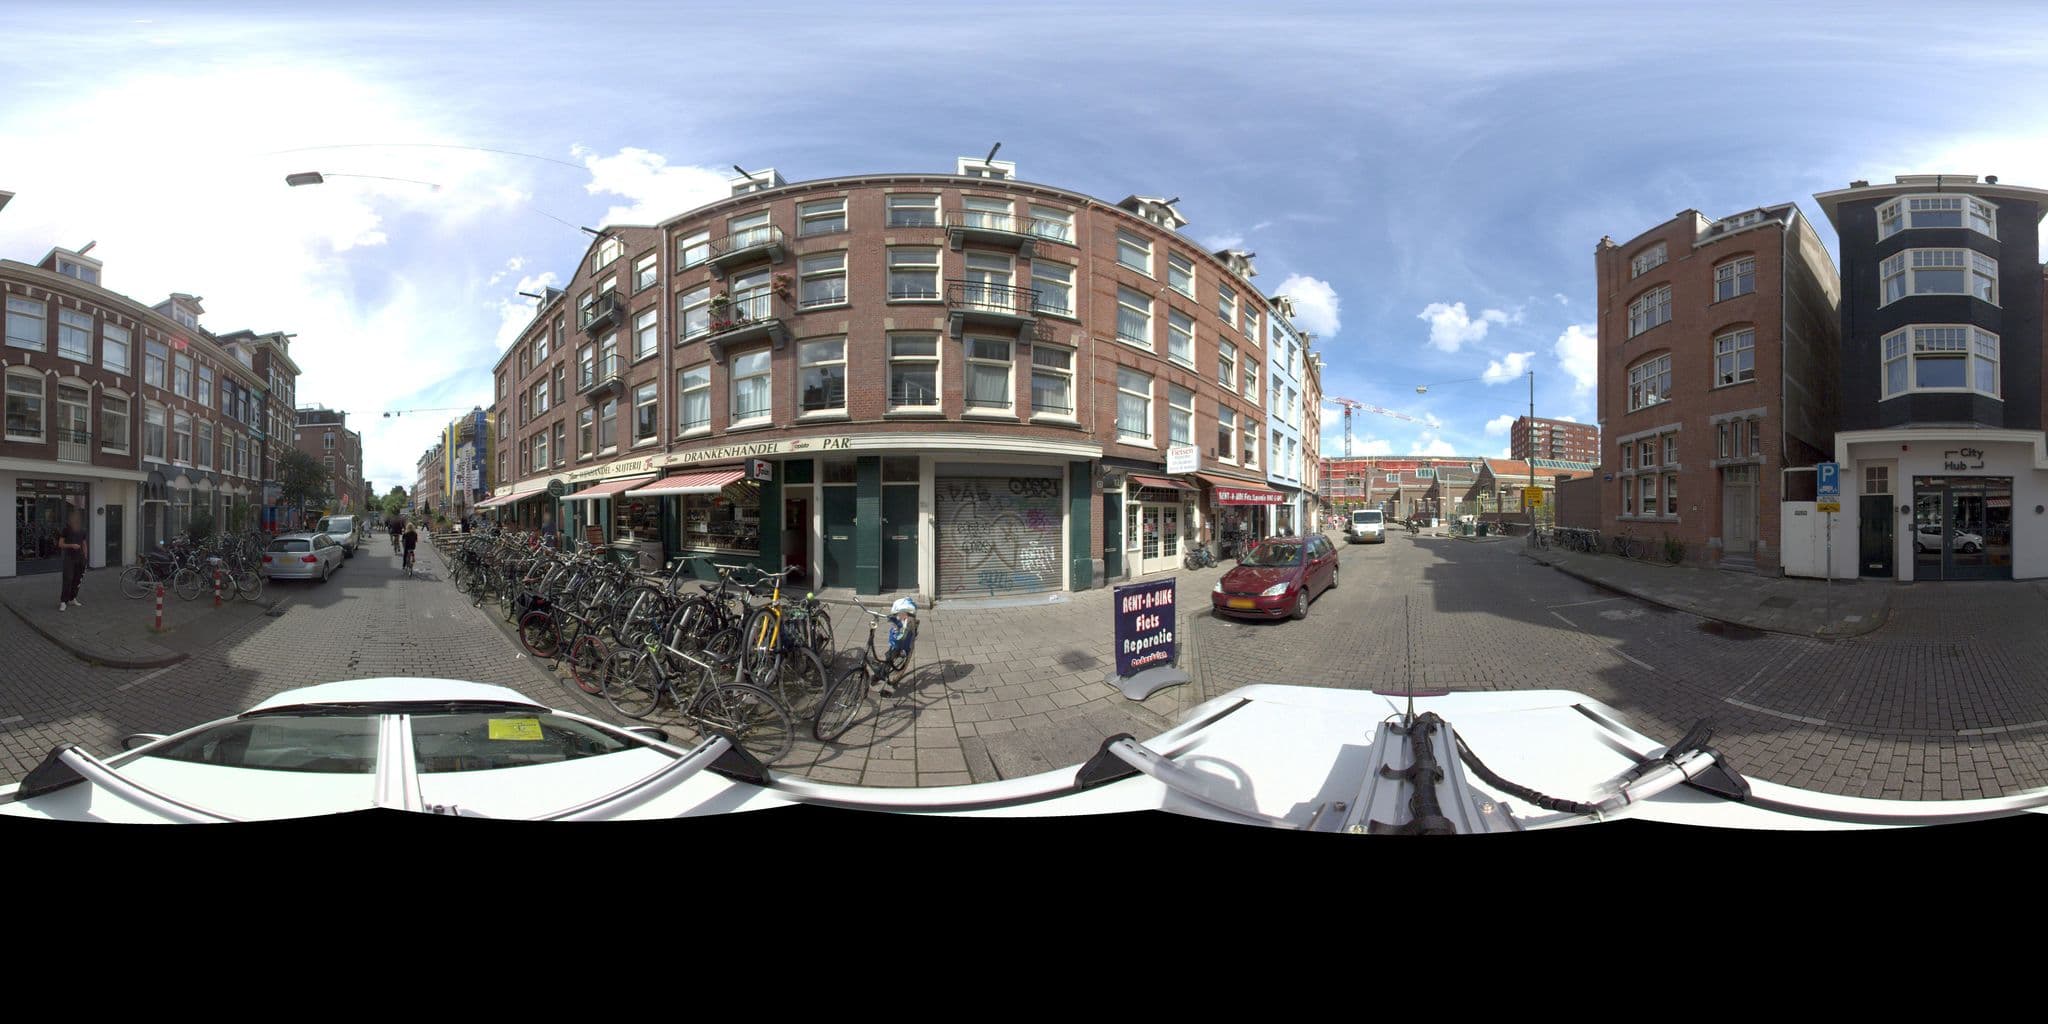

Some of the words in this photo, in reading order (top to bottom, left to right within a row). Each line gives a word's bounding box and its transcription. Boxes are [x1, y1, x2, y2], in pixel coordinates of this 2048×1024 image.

[822, 437, 850, 449] PAR
[684, 442, 780, 463] DRANKENHANDEL
[1960, 448, 1984, 461] City
[1822, 465, 1835, 483] P
[1944, 460, 1967, 471] Hub
[1136, 613, 1160, 632] Fiets
[1123, 628, 1172, 655] Reparatie
